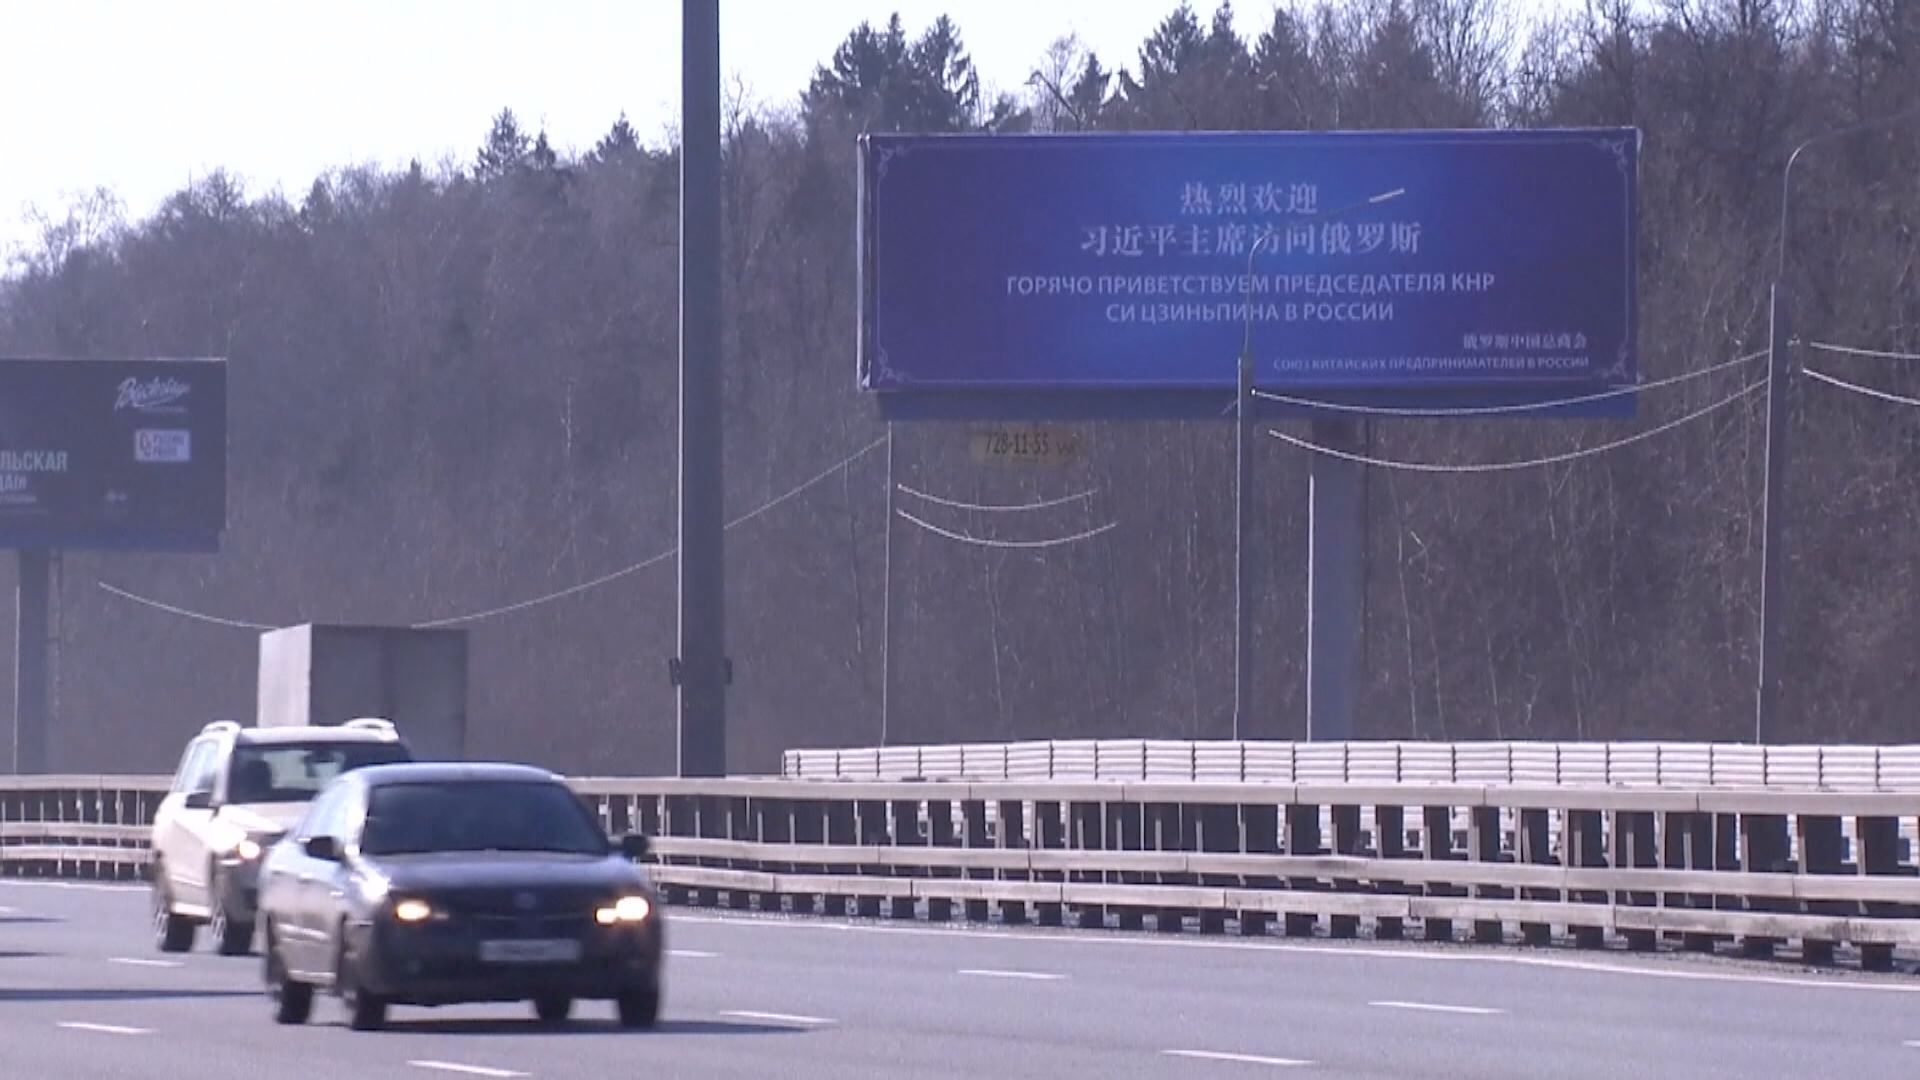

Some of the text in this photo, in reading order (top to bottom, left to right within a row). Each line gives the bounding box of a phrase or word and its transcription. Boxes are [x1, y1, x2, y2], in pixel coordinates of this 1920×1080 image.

[1181, 181, 1318, 215] 热烈欢迎
[1080, 221, 1422, 257] 习近平主席访问俄罗斯
[1006, 272, 1496, 297] ГОРЯЧО ПРИВЕТСТВУЕМ ПРЕДСЕДАТЕЛЯ КНР
[1106, 302, 1394, 325] СИ ЦЗИНЬПИНА В РОССИИ
[1537, 356, 1590, 369] РОССИИ
